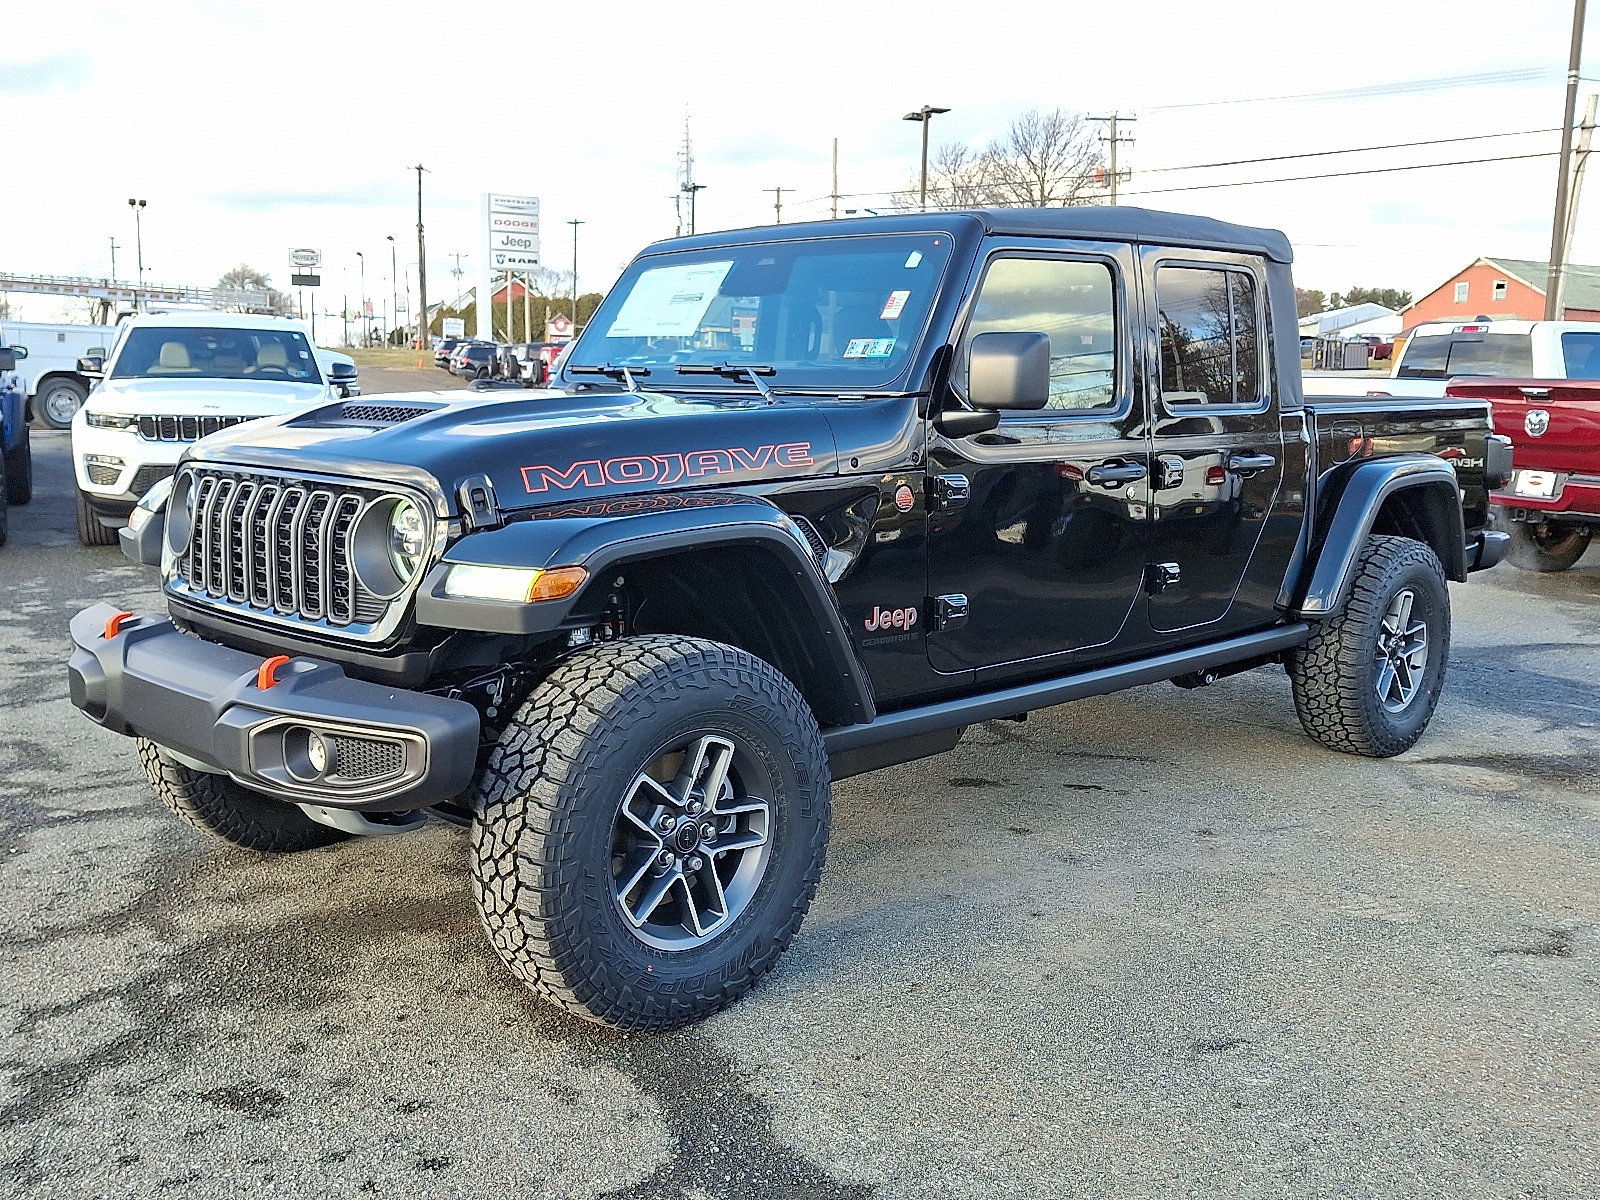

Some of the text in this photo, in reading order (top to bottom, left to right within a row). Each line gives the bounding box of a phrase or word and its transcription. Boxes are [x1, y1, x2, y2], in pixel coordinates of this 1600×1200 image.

[494, 219, 537, 228] DODGE
[501, 235, 532, 249] Jeep
[508, 257, 538, 265] RAM
[519, 441, 815, 493] MOJAVE
[864, 605, 918, 632] Jeep
